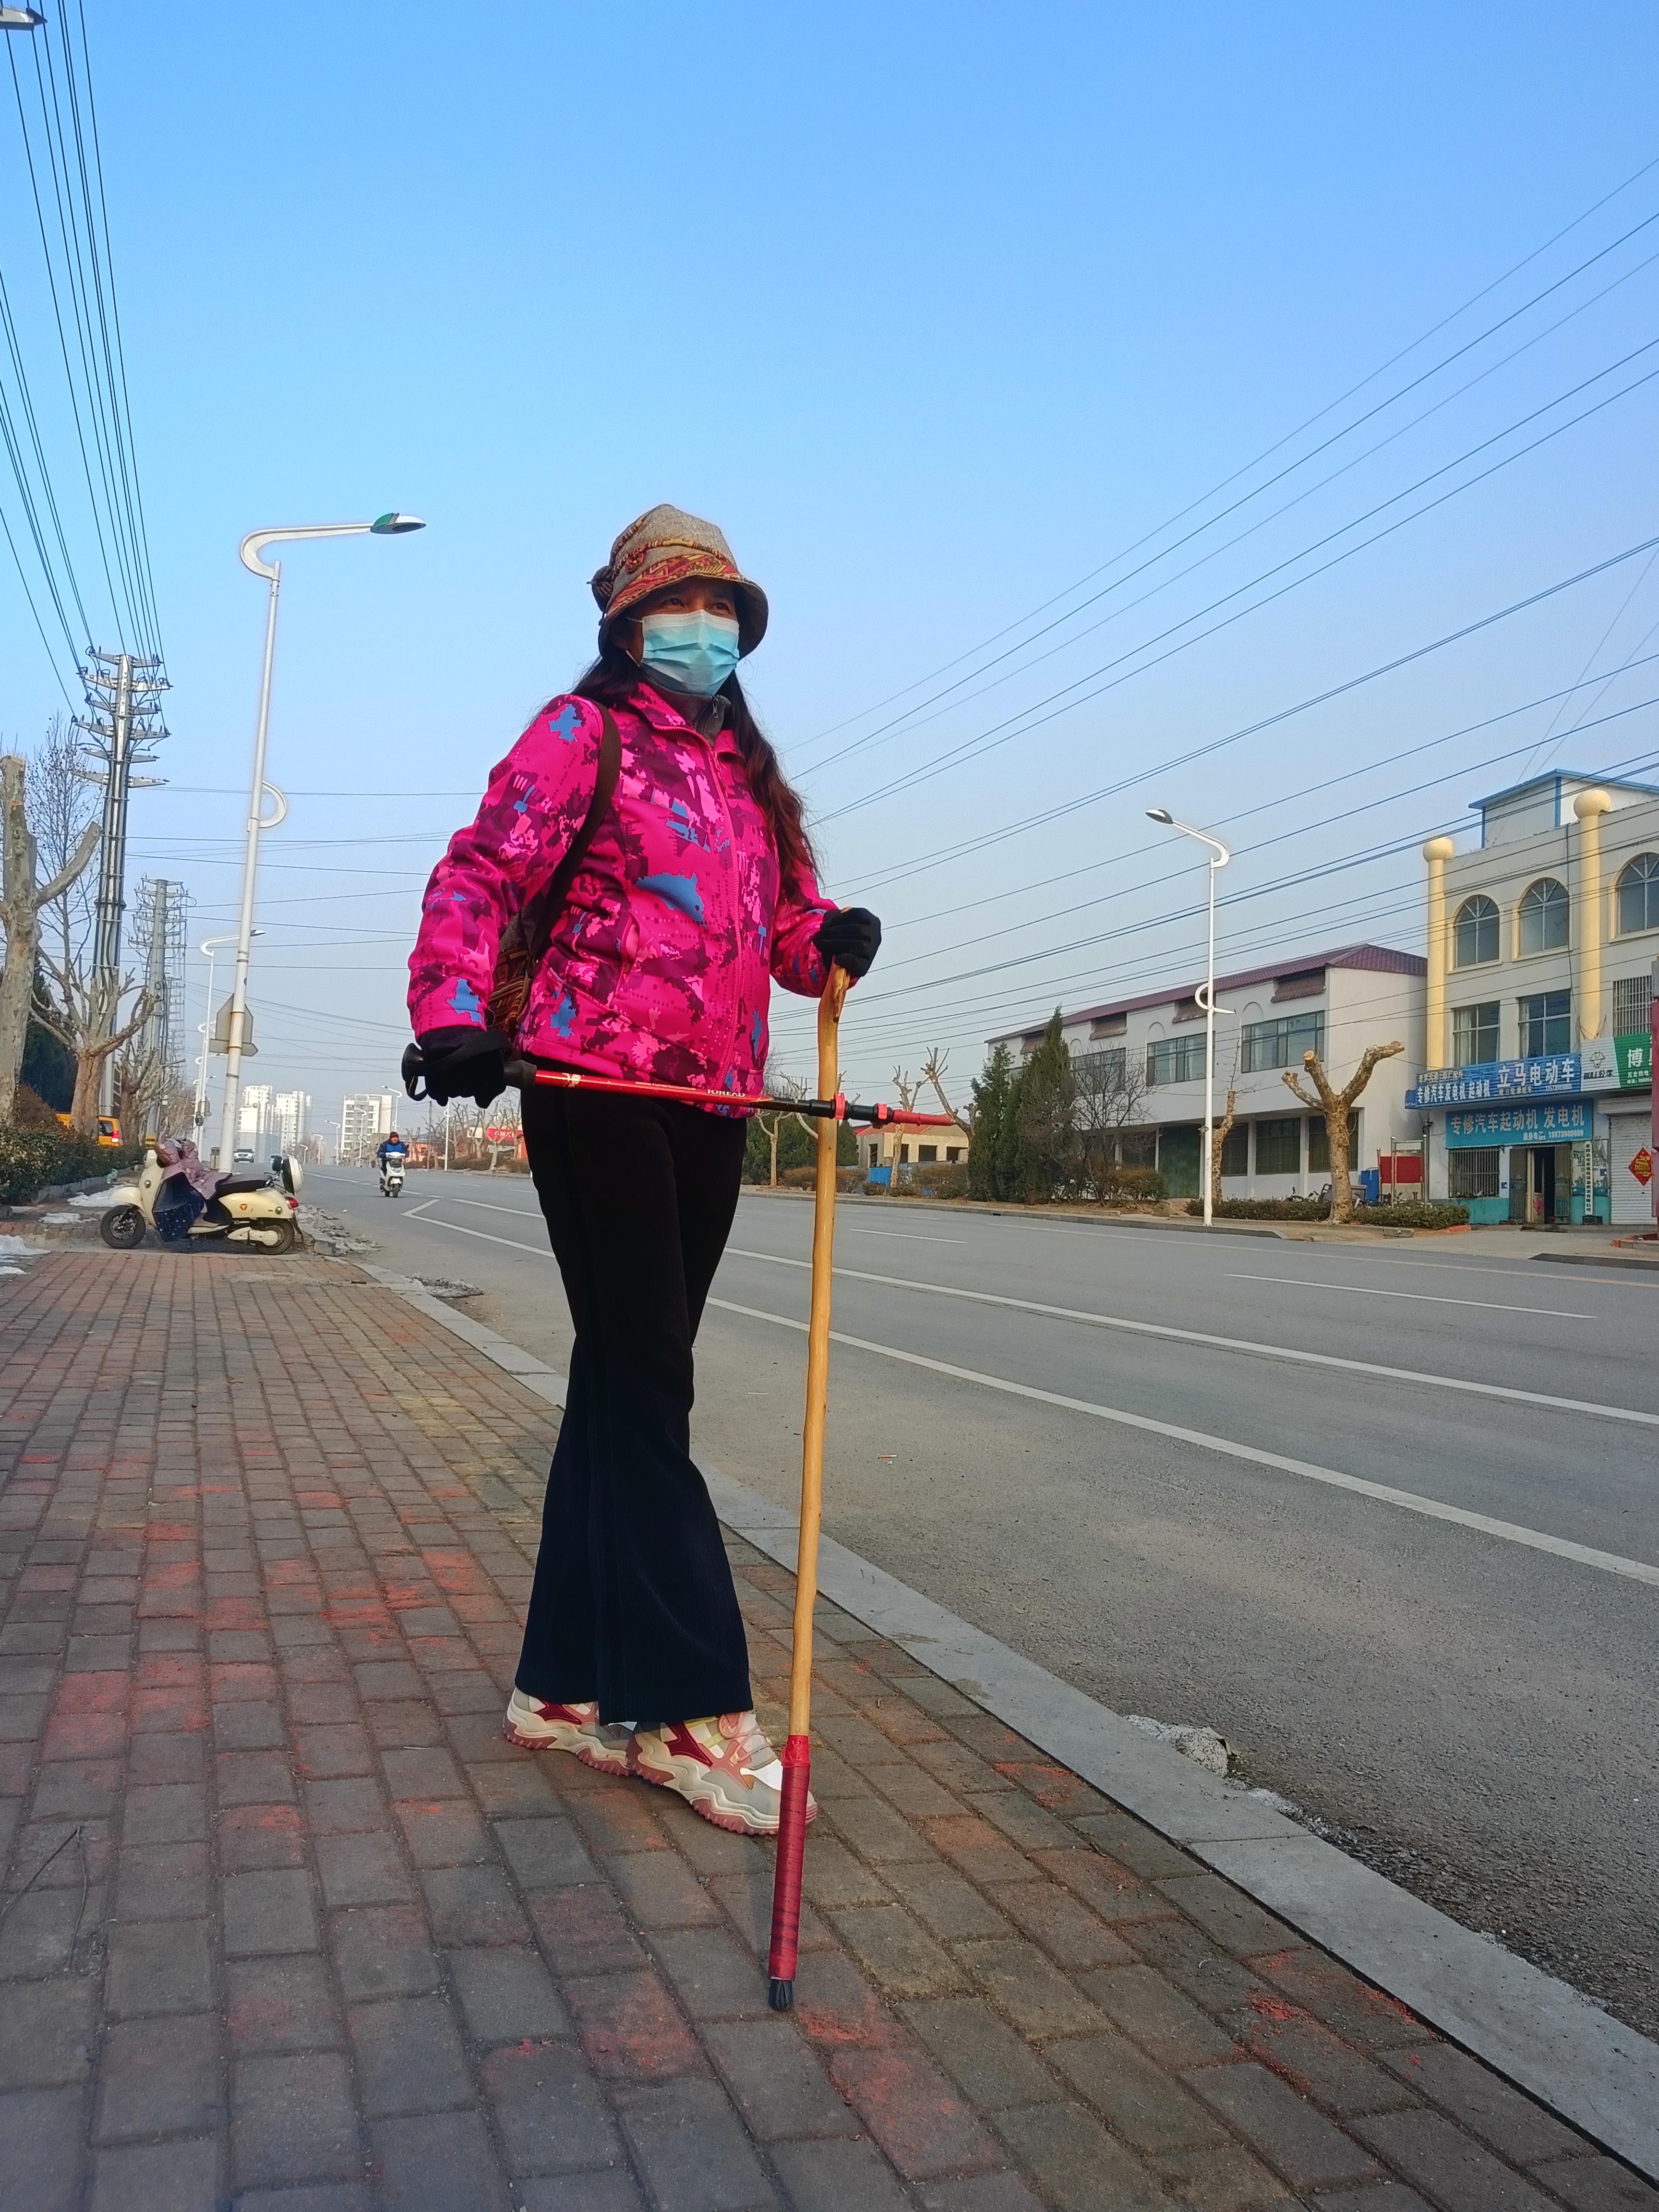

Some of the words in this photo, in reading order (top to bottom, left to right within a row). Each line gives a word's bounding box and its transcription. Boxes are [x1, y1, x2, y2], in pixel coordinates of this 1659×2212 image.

[1627, 1048, 1652, 1068] 博
[1497, 1058, 1575, 1088] 立马电动车
[1417, 1082, 1466, 1104] 专修汽车发电机
[1468, 1079, 1490, 1099] 起动机
[1451, 1108, 1538, 1135] 专修汽车起动机
[1543, 1105, 1585, 1129] 发电机
